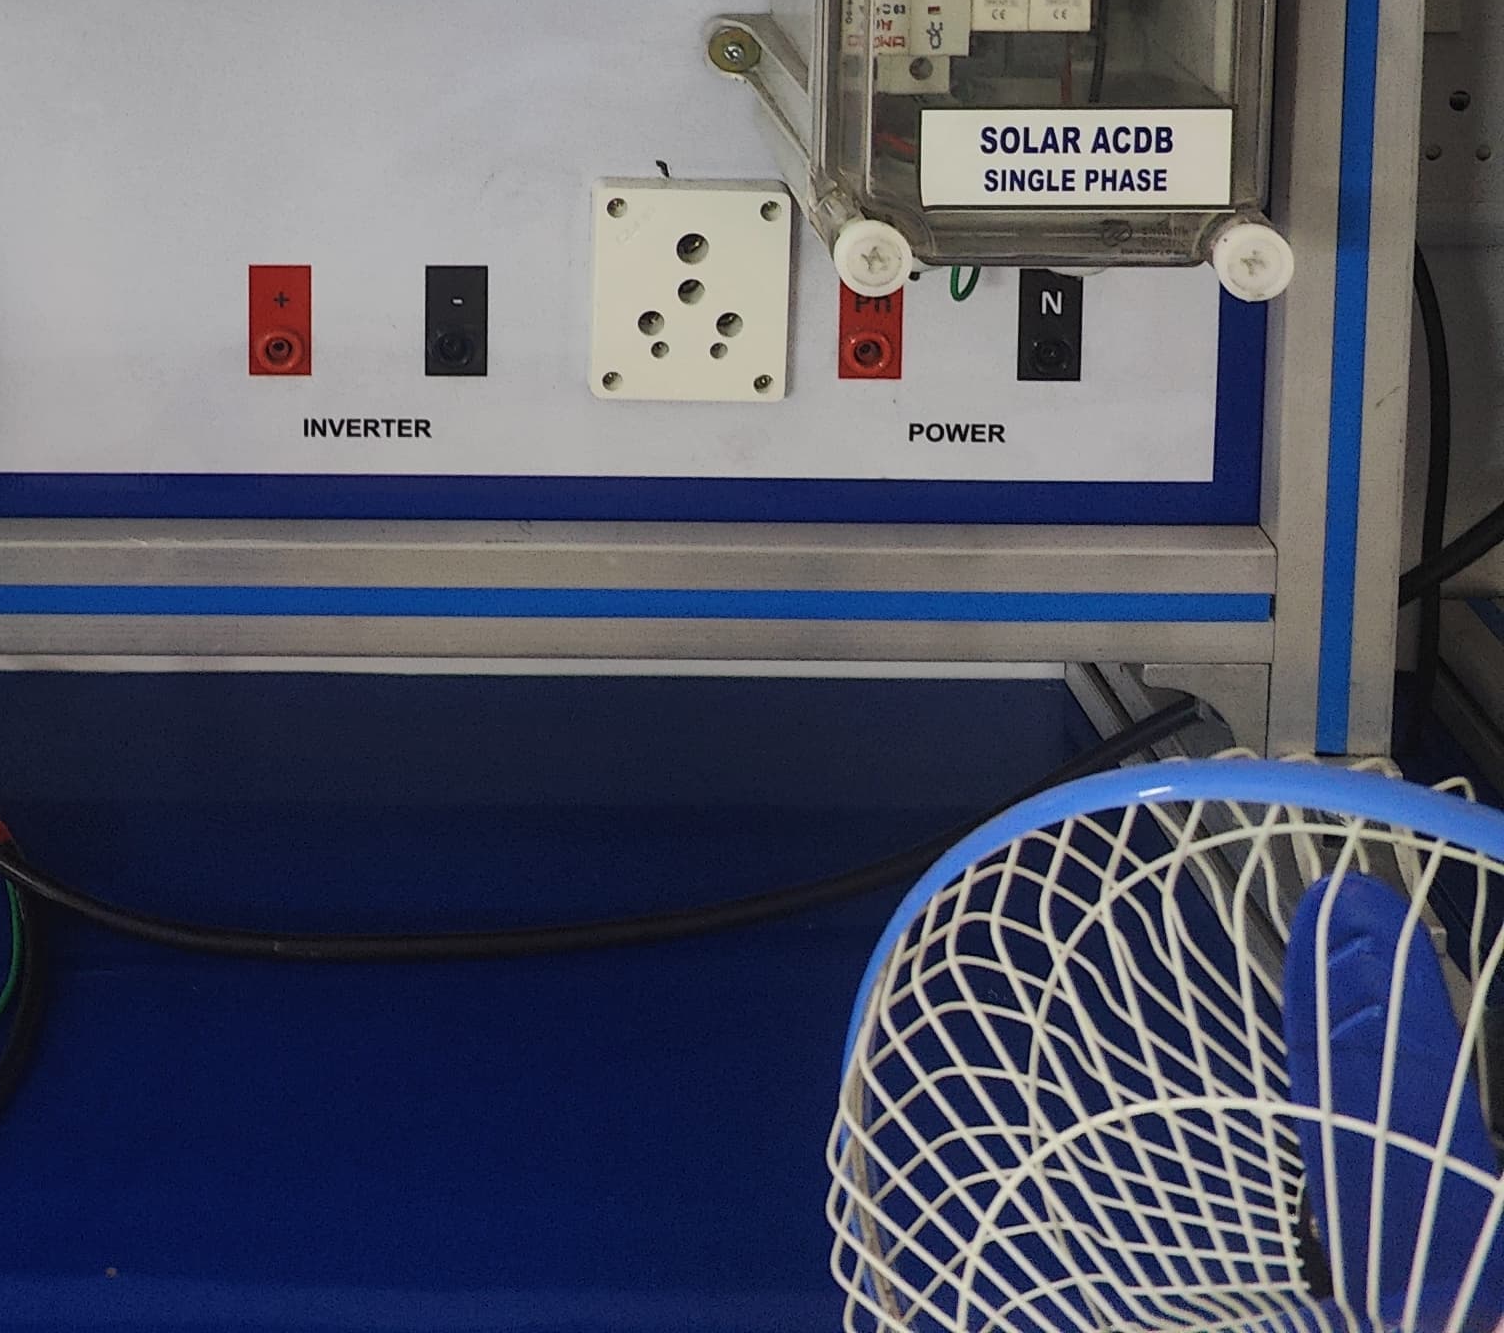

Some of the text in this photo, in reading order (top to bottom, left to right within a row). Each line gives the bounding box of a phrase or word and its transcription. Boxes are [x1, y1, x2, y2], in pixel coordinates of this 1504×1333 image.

[979, 125, 1174, 155] SOLAR ACDB
[983, 167, 1168, 193] SINGLE PHASE
[1041, 290, 1063, 315] N
[303, 418, 433, 439] INVERTER
[908, 422, 1006, 444] POWER
